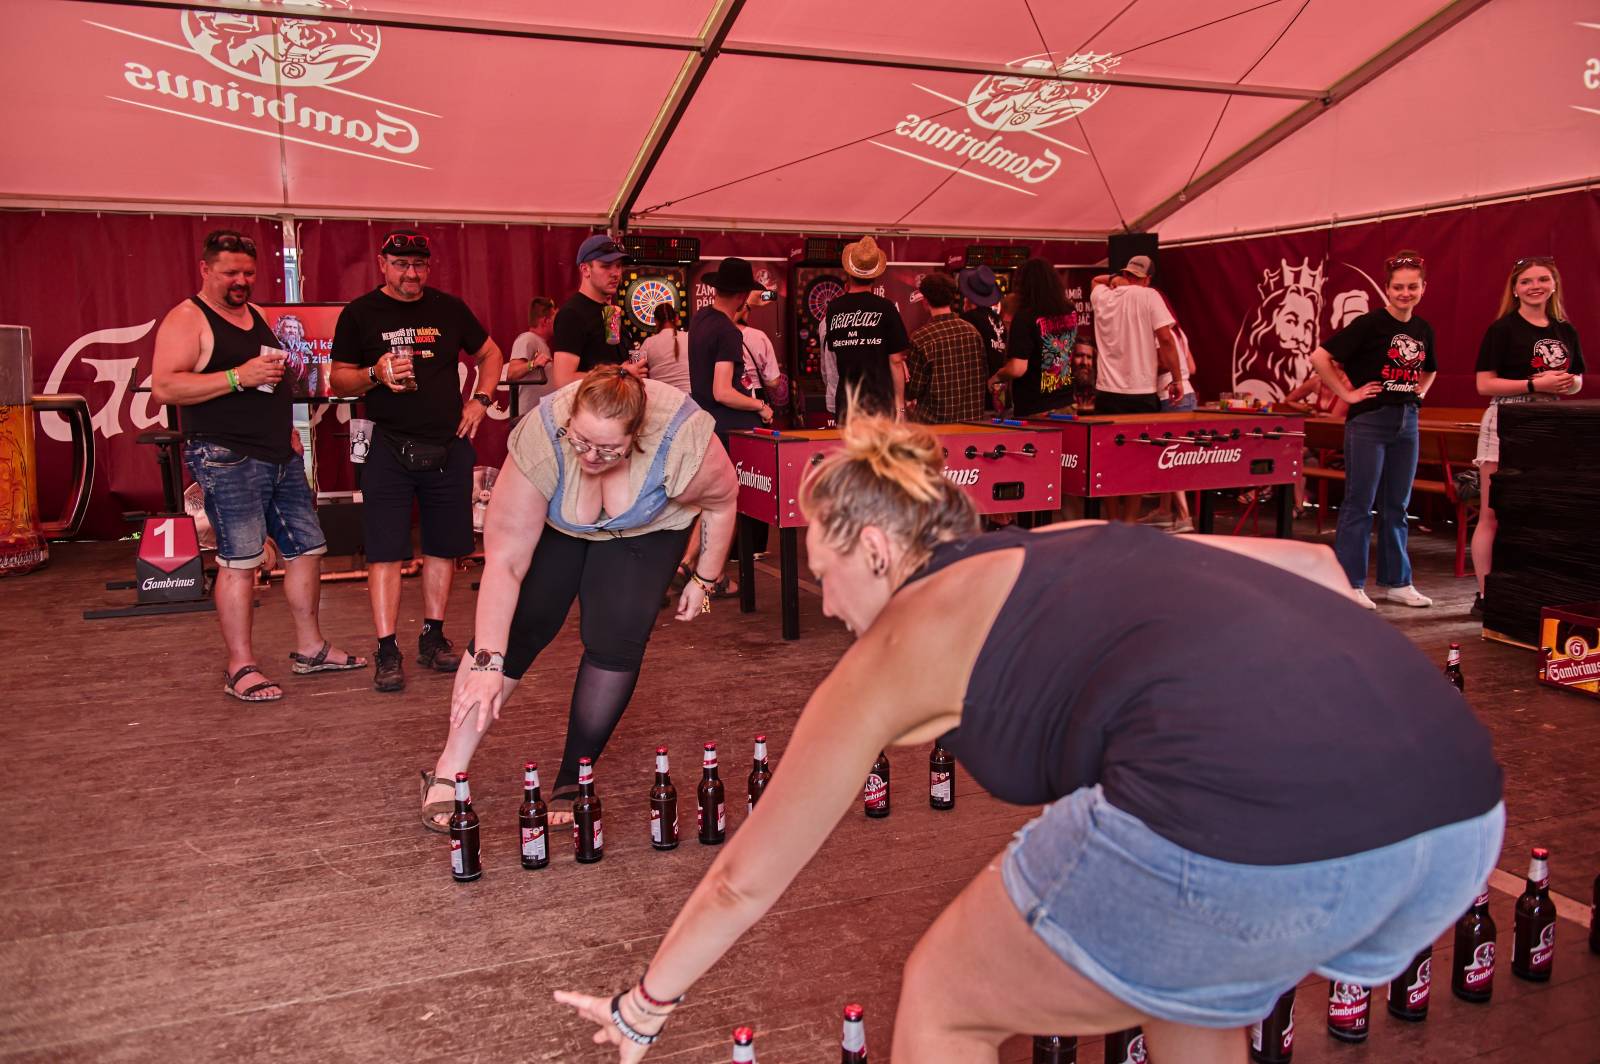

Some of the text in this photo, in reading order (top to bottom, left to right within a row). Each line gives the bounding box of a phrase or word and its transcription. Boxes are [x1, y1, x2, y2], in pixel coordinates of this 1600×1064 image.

[696, 296, 715, 311] PŘÍ
[1157, 443, 1242, 470] Gambrinus
[735, 460, 772, 493] Gambrinus
[153, 518, 175, 558] 1
[141, 576, 195, 591] Gambrinus
[1549, 660, 1600, 681] Gambrinus
[1329, 1002, 1368, 1017] Gambrinus
[1355, 1018, 1365, 1027] 10
